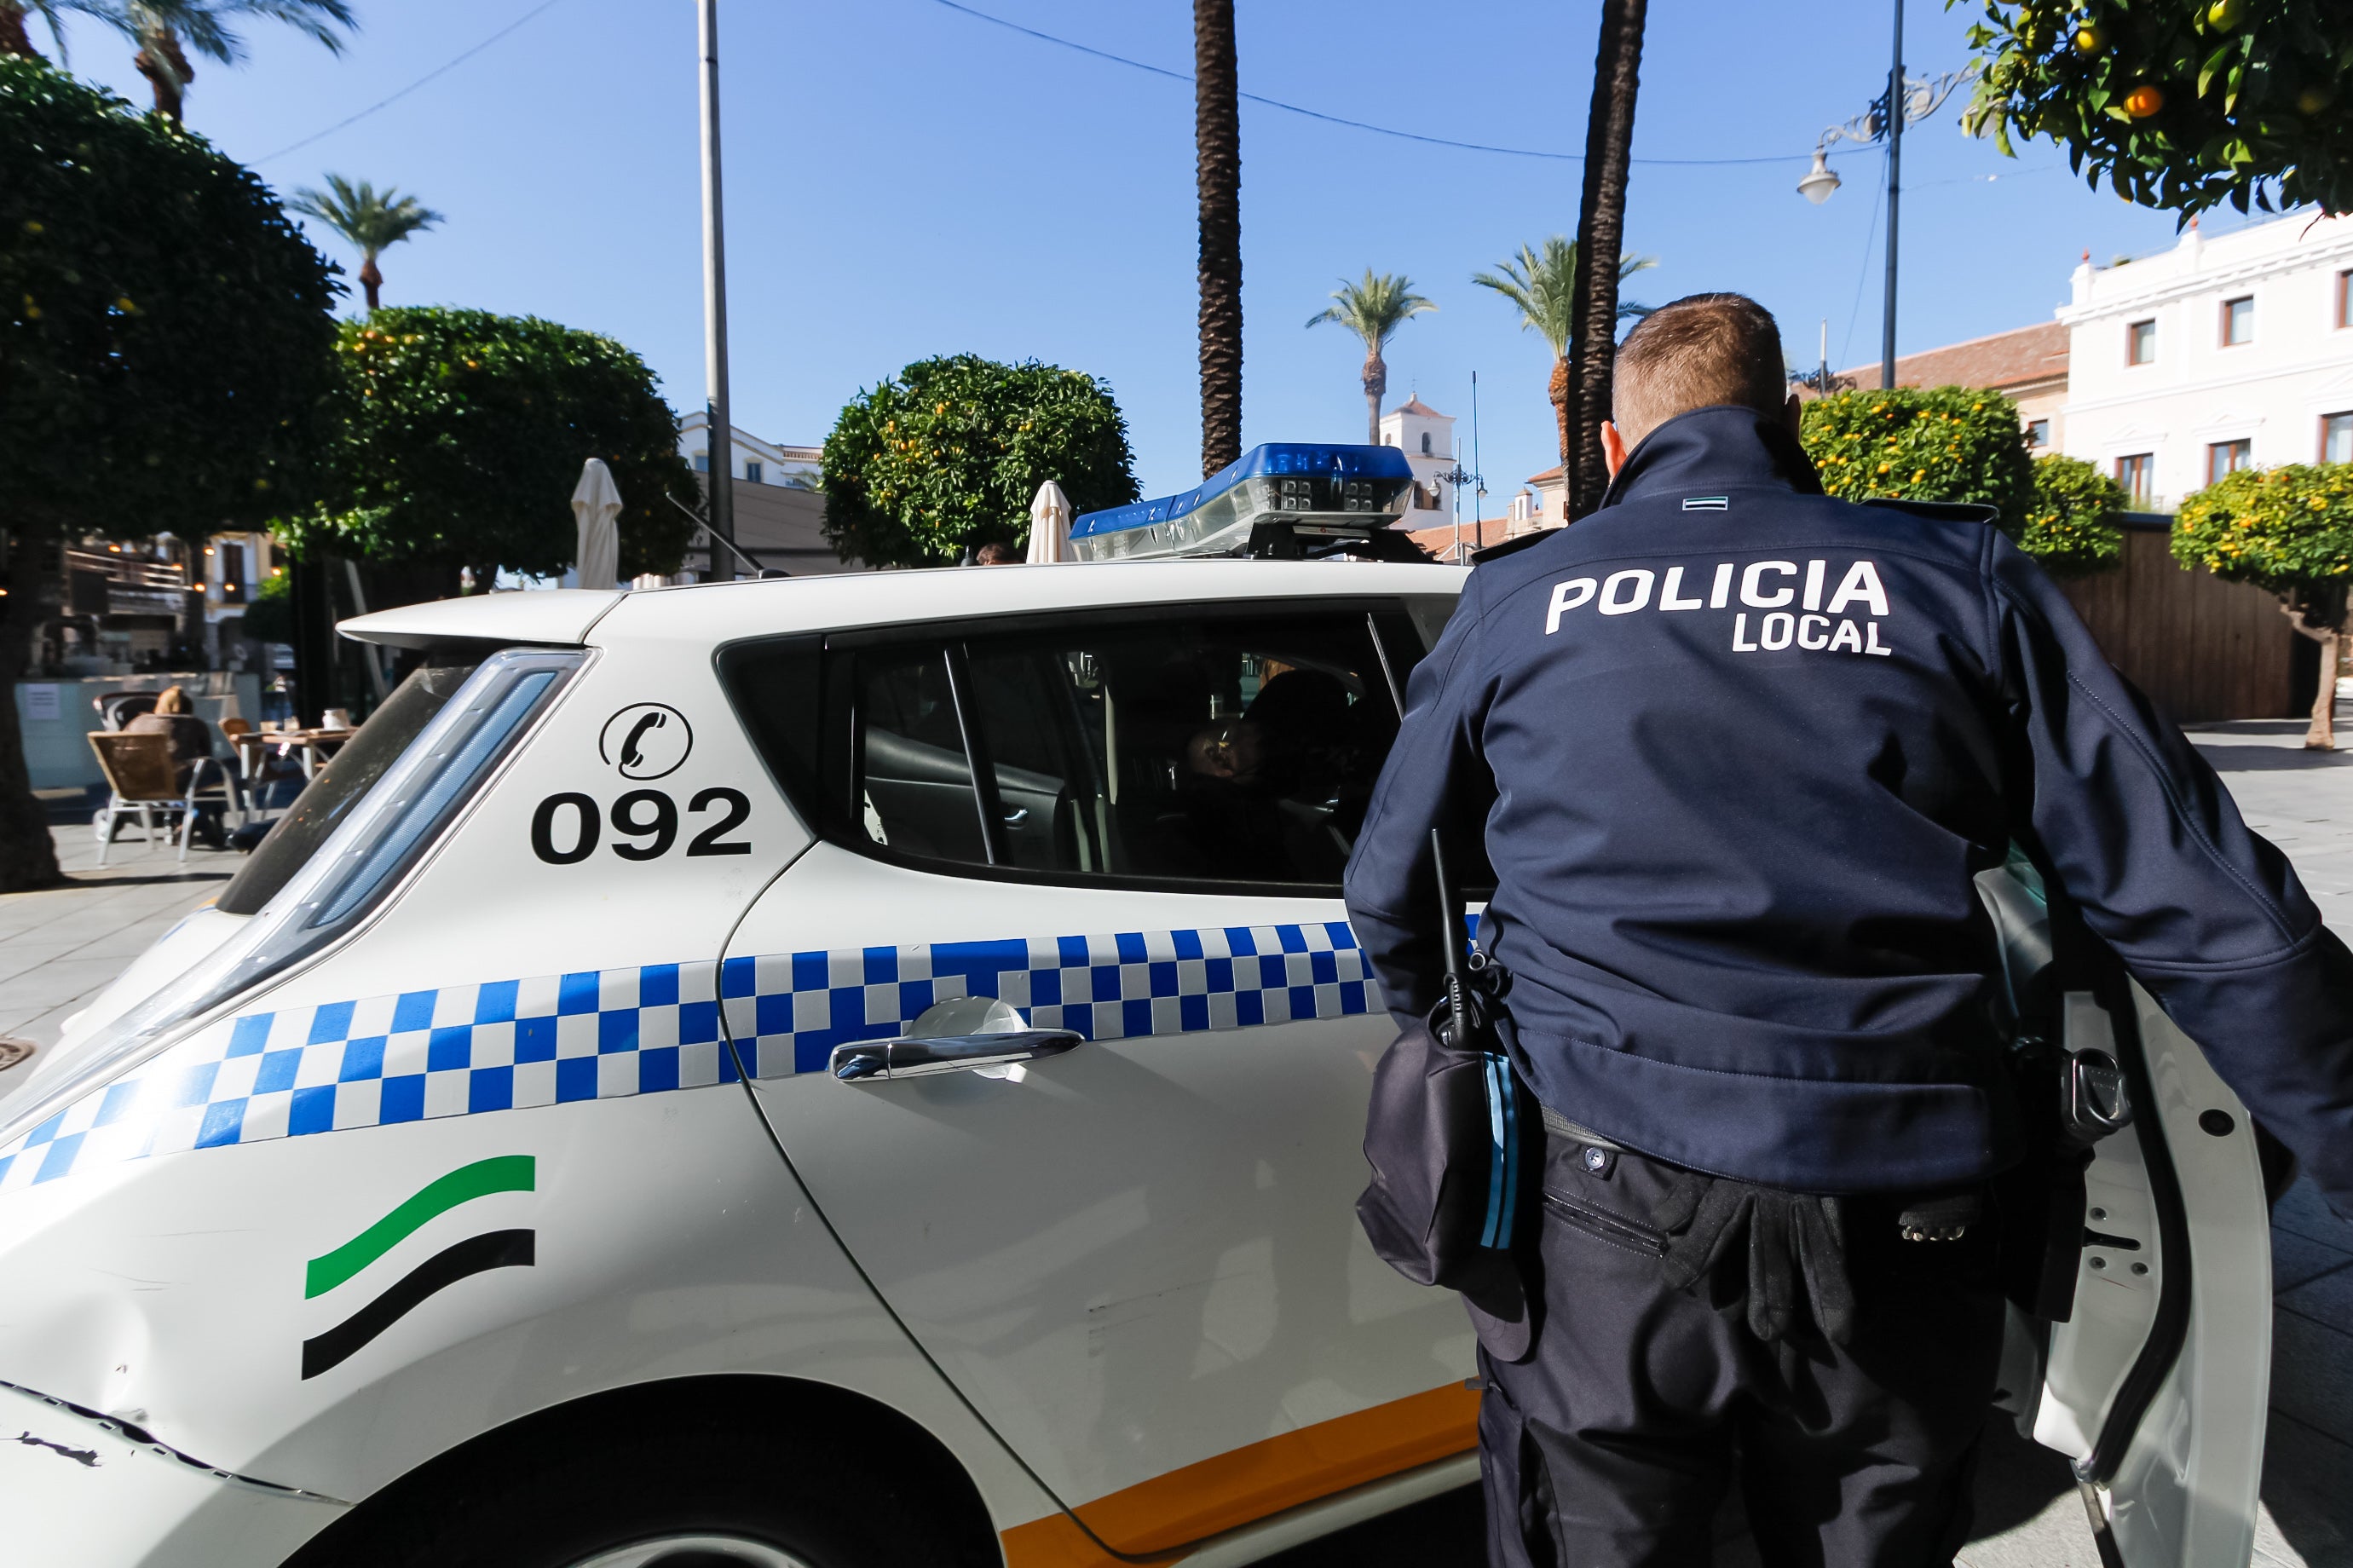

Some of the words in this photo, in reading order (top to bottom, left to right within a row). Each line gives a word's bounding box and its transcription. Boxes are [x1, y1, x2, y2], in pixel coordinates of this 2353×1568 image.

[1545, 559, 1889, 636] POLICIA
[1732, 612, 1892, 656] LOCAL
[531, 787, 752, 865] 092
